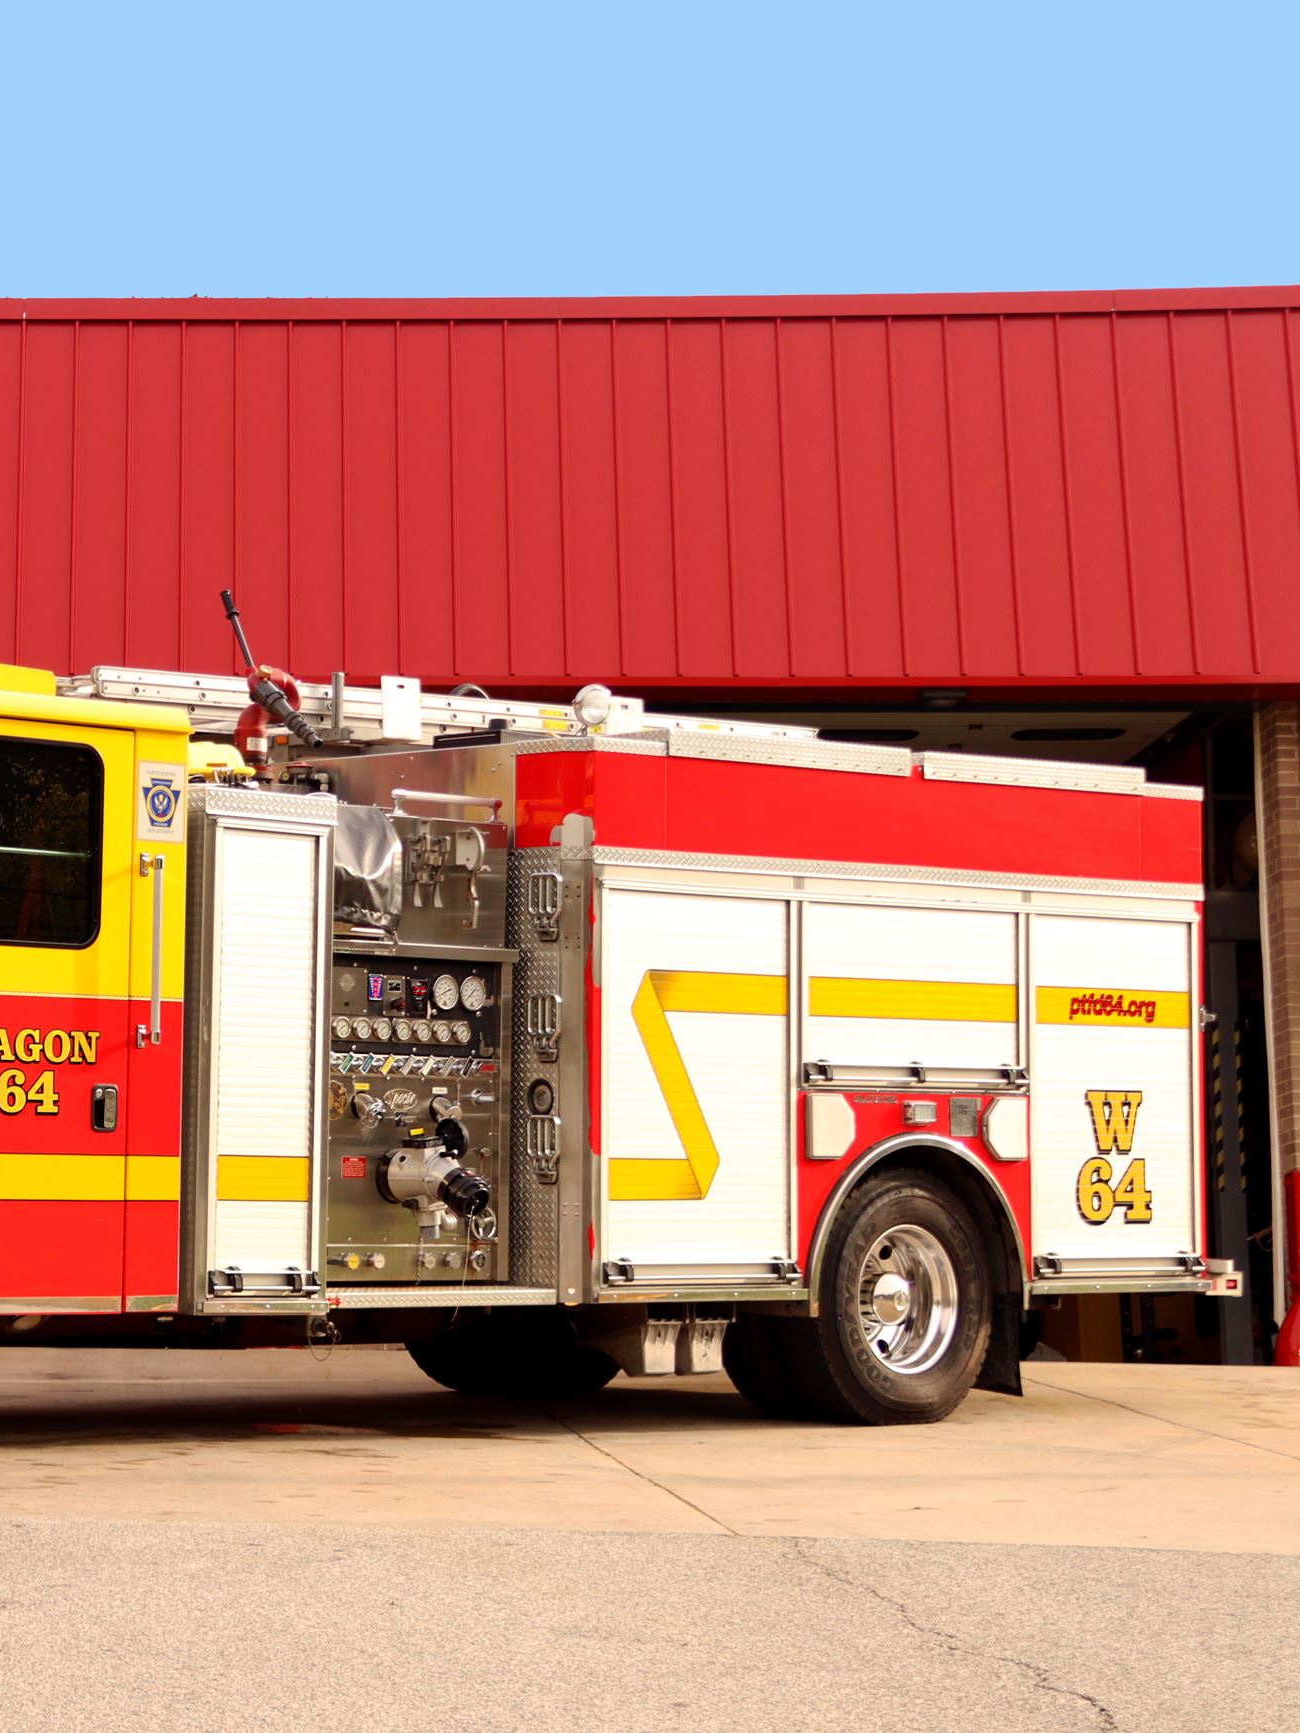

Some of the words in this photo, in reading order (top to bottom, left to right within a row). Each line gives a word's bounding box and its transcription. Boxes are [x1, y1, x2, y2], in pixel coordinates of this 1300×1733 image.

[1069, 993, 1157, 1024] ptfd64.org
[1084, 1089, 1143, 1155] W
[1076, 1156, 1152, 1226] 64
[843, 1220, 894, 1392] GOODYEAR
